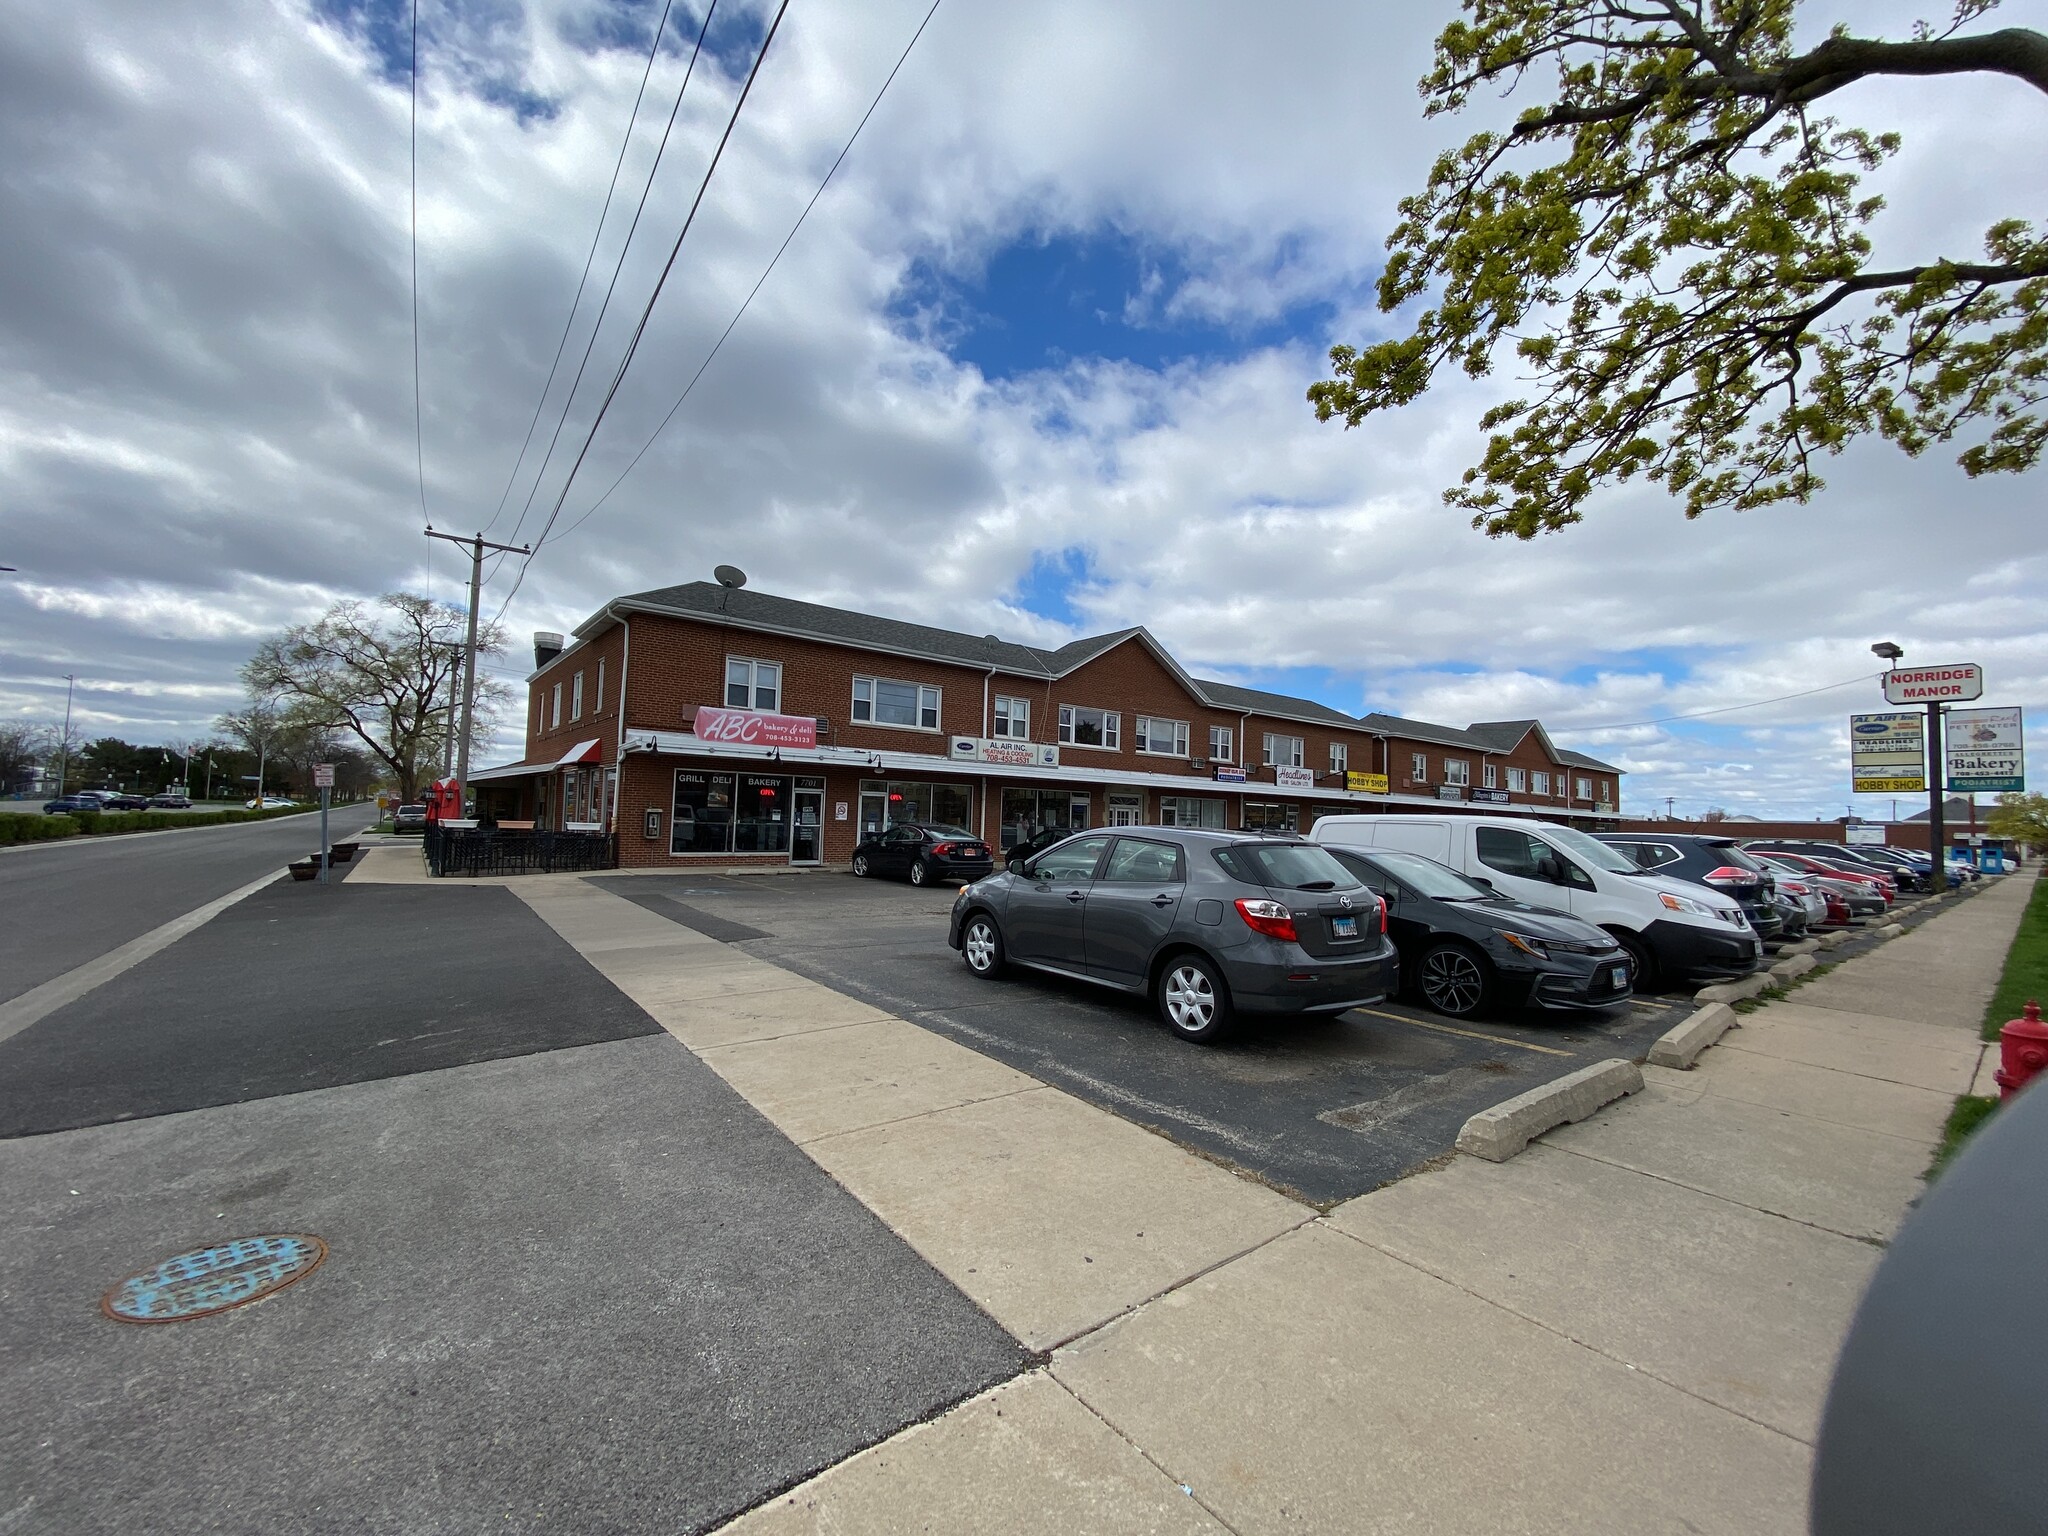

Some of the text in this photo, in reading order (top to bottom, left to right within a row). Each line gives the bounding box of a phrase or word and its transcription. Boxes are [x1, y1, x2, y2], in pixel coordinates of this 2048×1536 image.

[1891, 669, 1974, 684] NORRIDGE
[1903, 685, 1962, 697] MANOR
[703, 714, 762, 742] ABC
[763, 722, 812, 735] bakery & deli
[765, 734, 810, 743] 708-453-3123
[982, 748, 1006, 756] HEATING
[1949, 758, 2019, 770] Bakery
[1278, 767, 1311, 780] Headlines
[679, 775, 781, 787] GRILL DELI BAKERY
[800, 779, 817, 787] 7701
[1347, 777, 1388, 788] HOBBY SHOP
[1855, 780, 1921, 790] HOBBY SHOP
[1491, 792, 1509, 802] BAKERY
